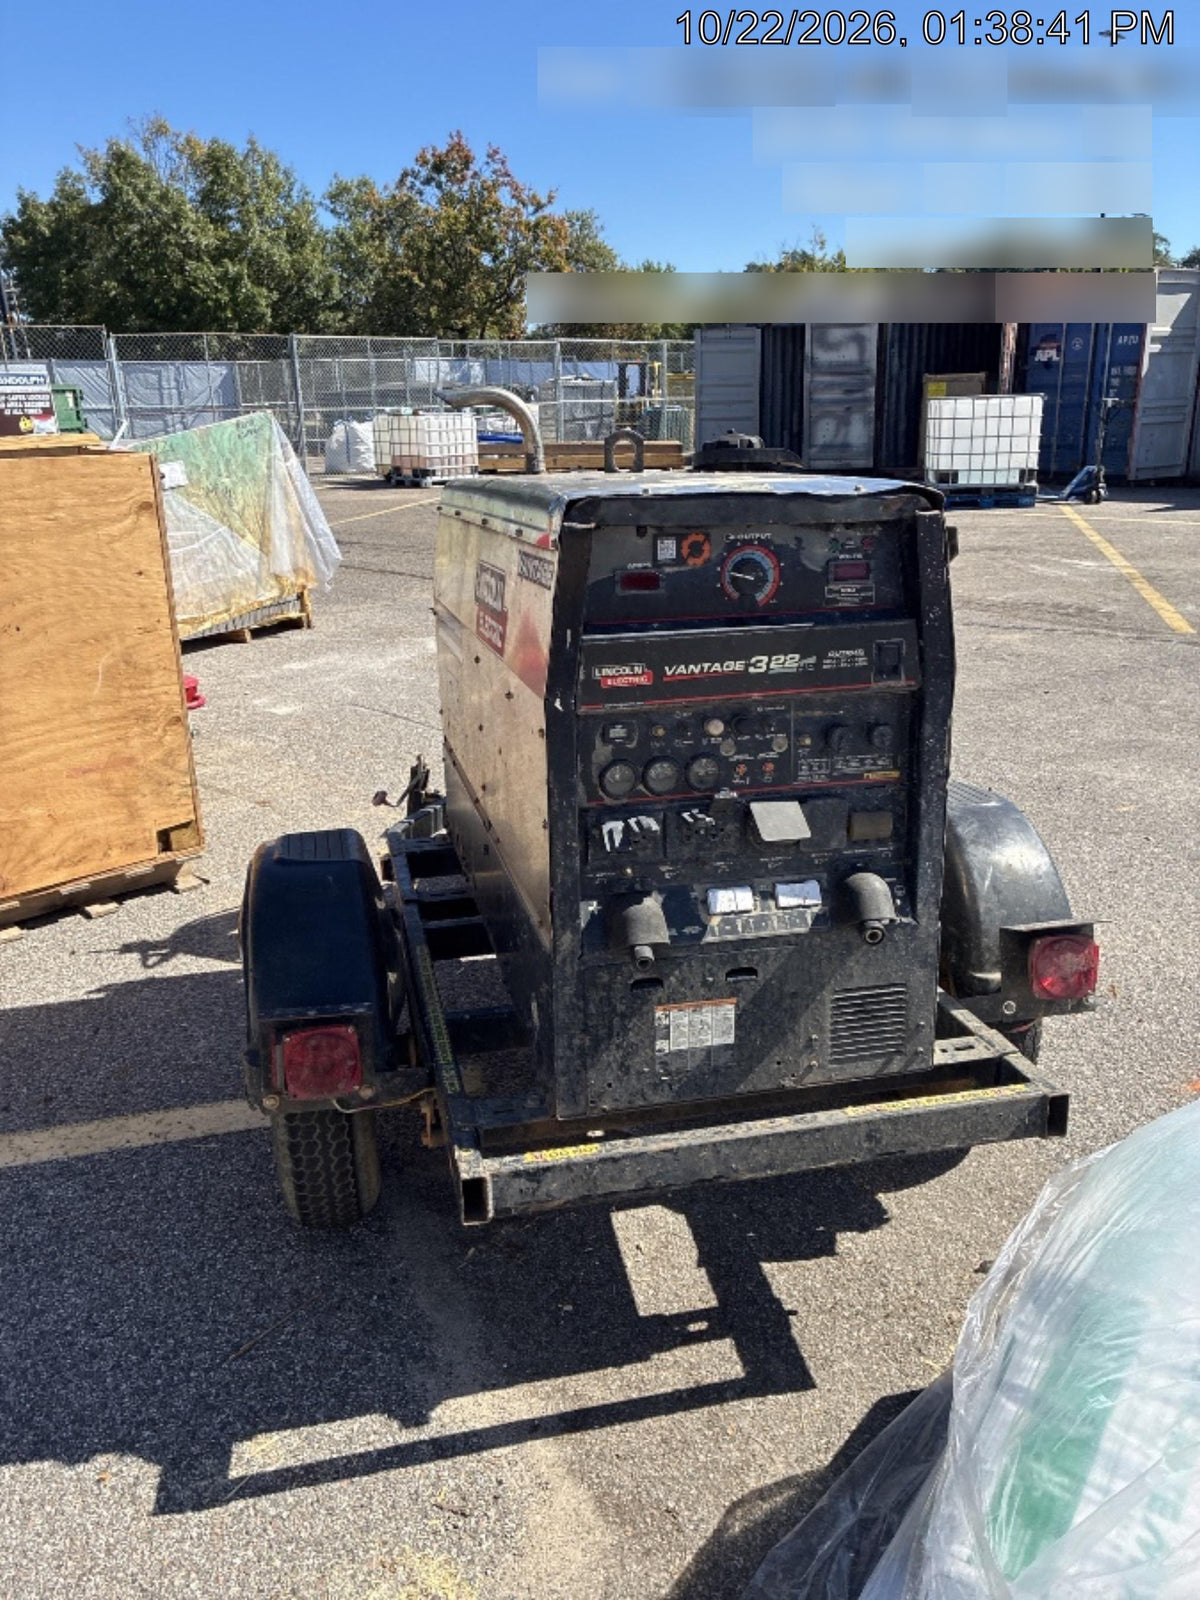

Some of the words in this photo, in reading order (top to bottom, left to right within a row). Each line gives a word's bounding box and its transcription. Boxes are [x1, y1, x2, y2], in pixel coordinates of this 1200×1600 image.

[594, 665, 643, 677] LINCOLN
[664, 662, 746, 677] VANTAGE
[748, 653, 801, 674] 322
[606, 675, 648, 686] ELECTRIC
